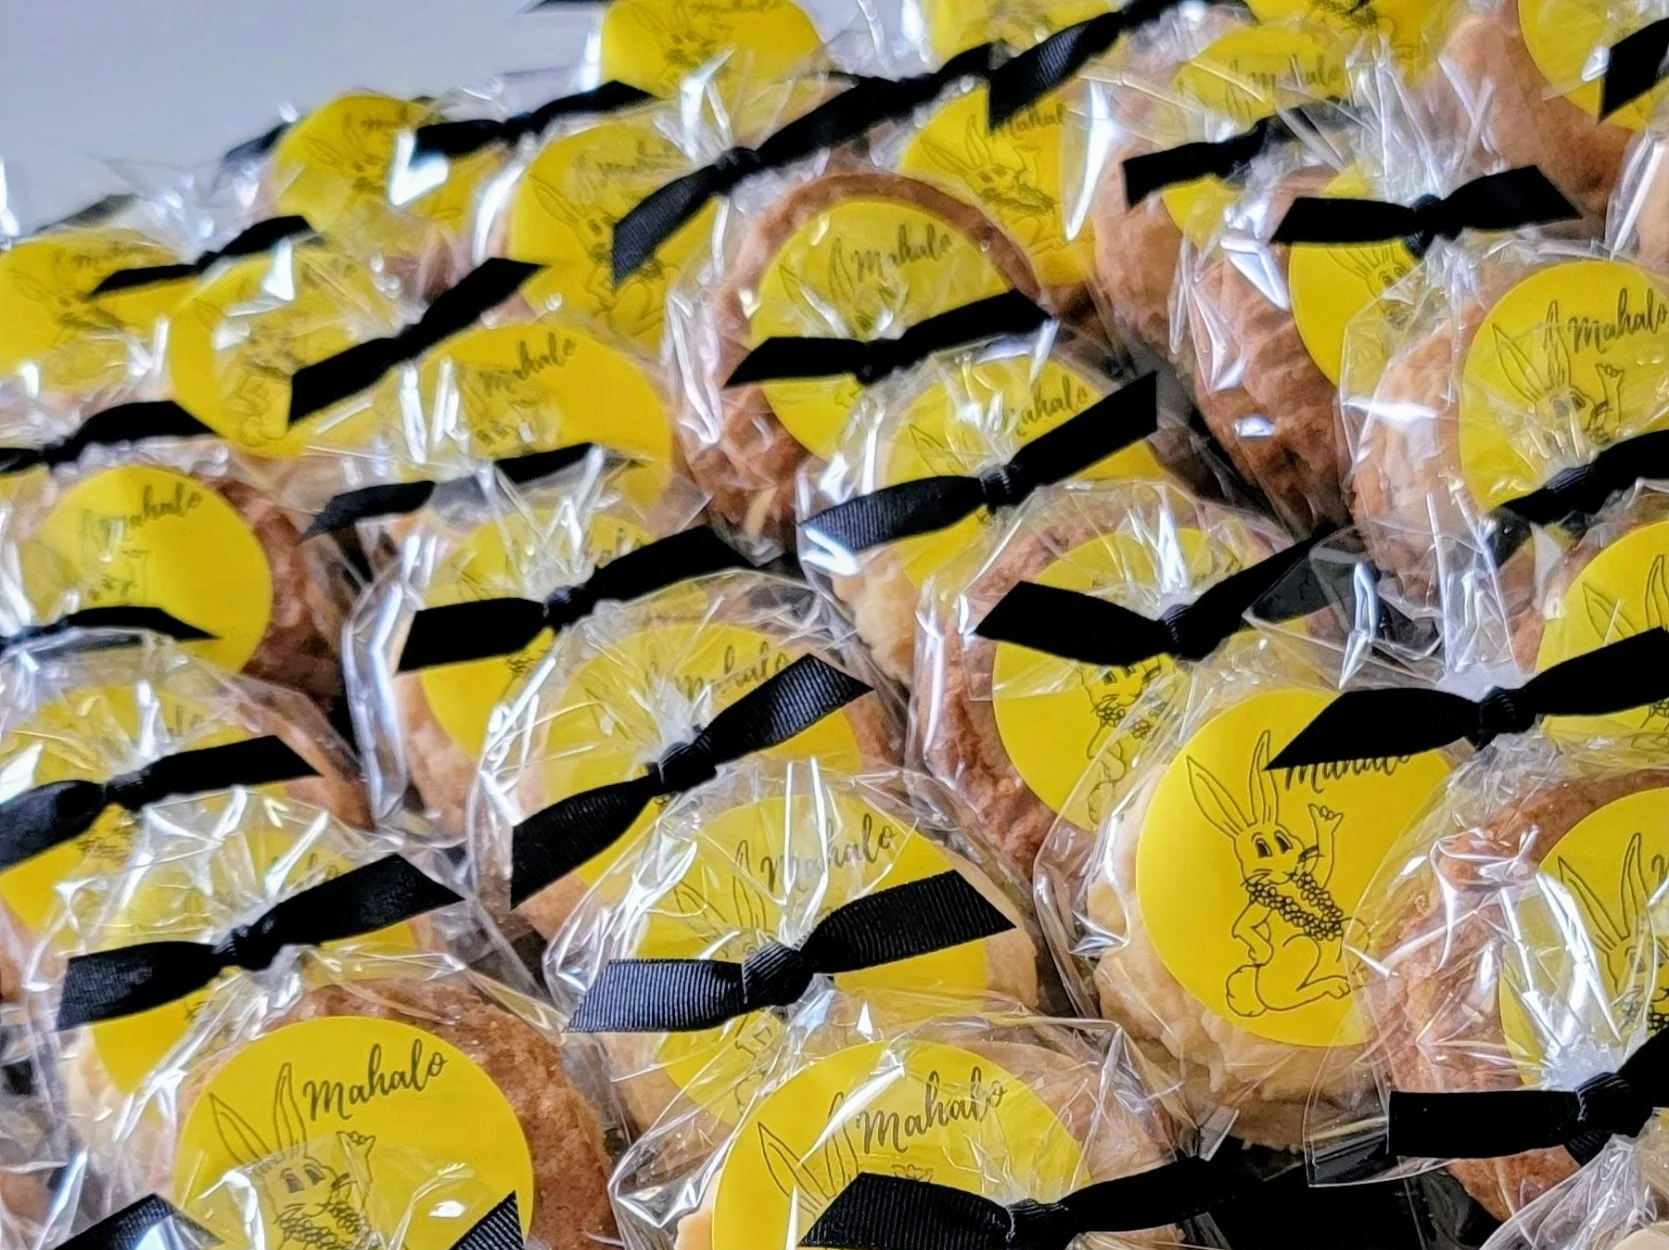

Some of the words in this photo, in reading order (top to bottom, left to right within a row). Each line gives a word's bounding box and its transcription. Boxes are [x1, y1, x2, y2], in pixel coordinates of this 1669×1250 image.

[1566, 287, 1668, 355] Mahalo
[303, 1038, 448, 1122] Mahalo
[856, 1066, 1008, 1155] Mahalo
